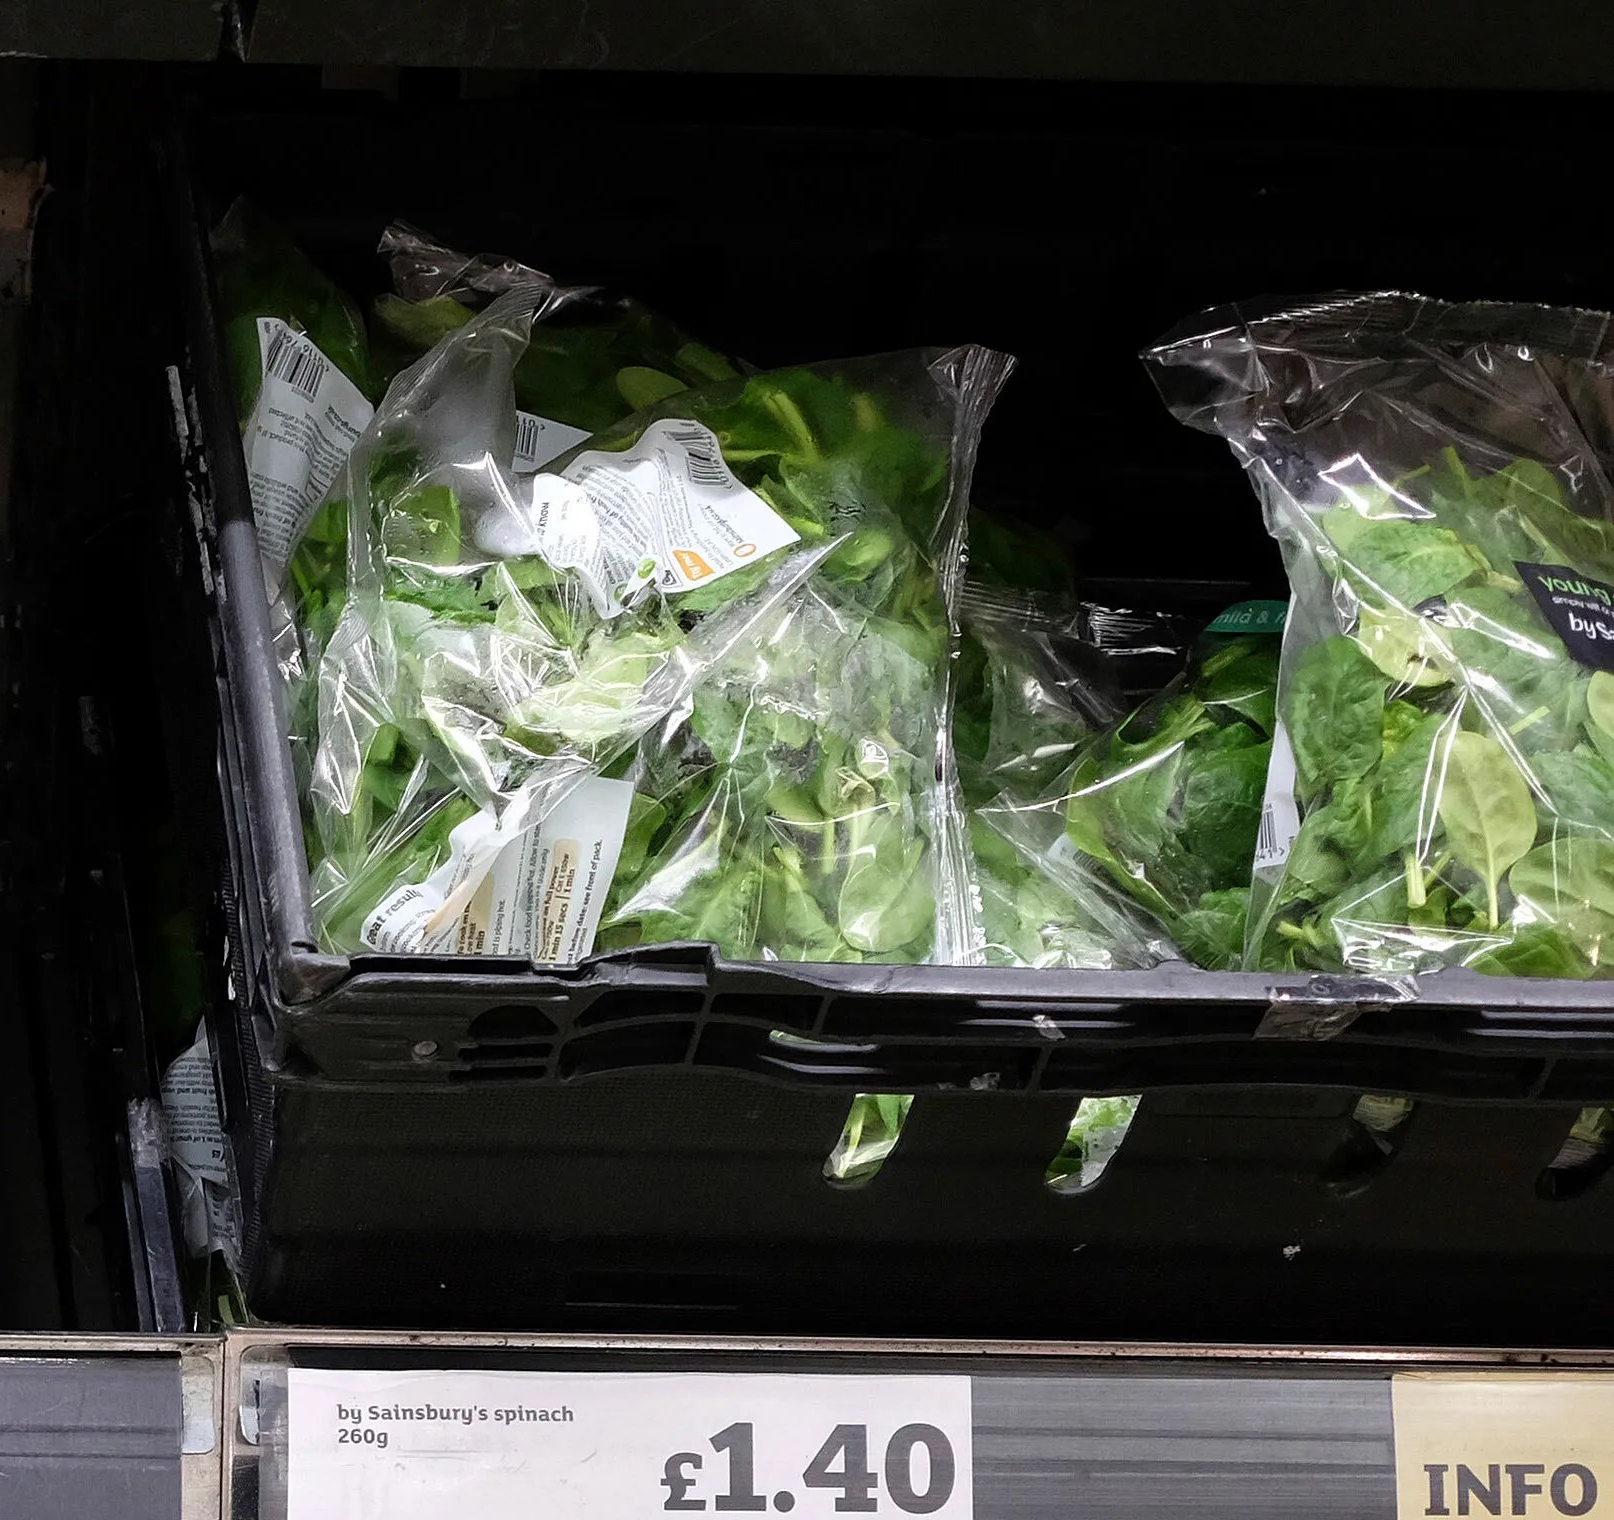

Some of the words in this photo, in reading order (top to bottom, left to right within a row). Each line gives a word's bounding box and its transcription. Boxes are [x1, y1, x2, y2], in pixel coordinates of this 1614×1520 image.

[1537, 576, 1611, 607] young
[1569, 611, 1596, 639] by
[337, 1404, 362, 1423] by
[369, 1404, 488, 1425] Sainsbury's
[494, 1405, 574, 1425] spinach
[338, 1429, 388, 1448] 260g
[660, 1422, 956, 1515] £1.40
[1424, 1463, 1598, 1517] INFO
